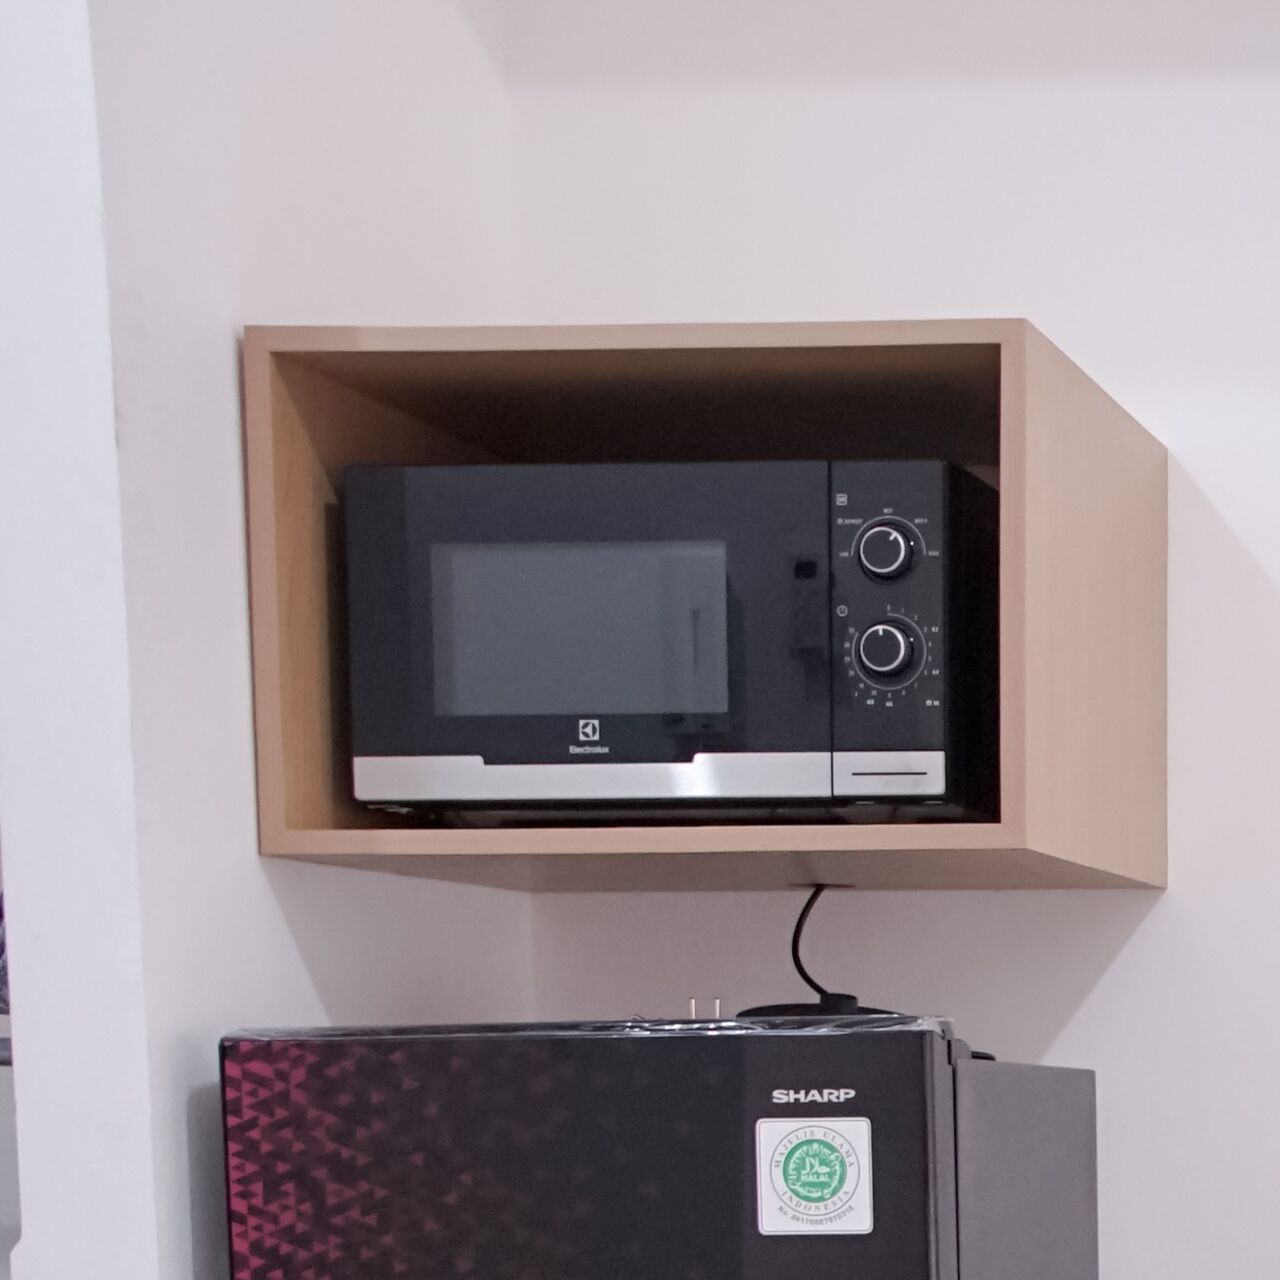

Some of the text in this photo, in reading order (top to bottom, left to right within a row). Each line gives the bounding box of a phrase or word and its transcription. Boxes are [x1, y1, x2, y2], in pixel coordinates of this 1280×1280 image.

[569, 745, 610, 754] Electrolux
[772, 1088, 856, 1104] SHARP
[823, 1131, 855, 1167] ULAMA
[782, 1190, 851, 1212] INDONESIA
